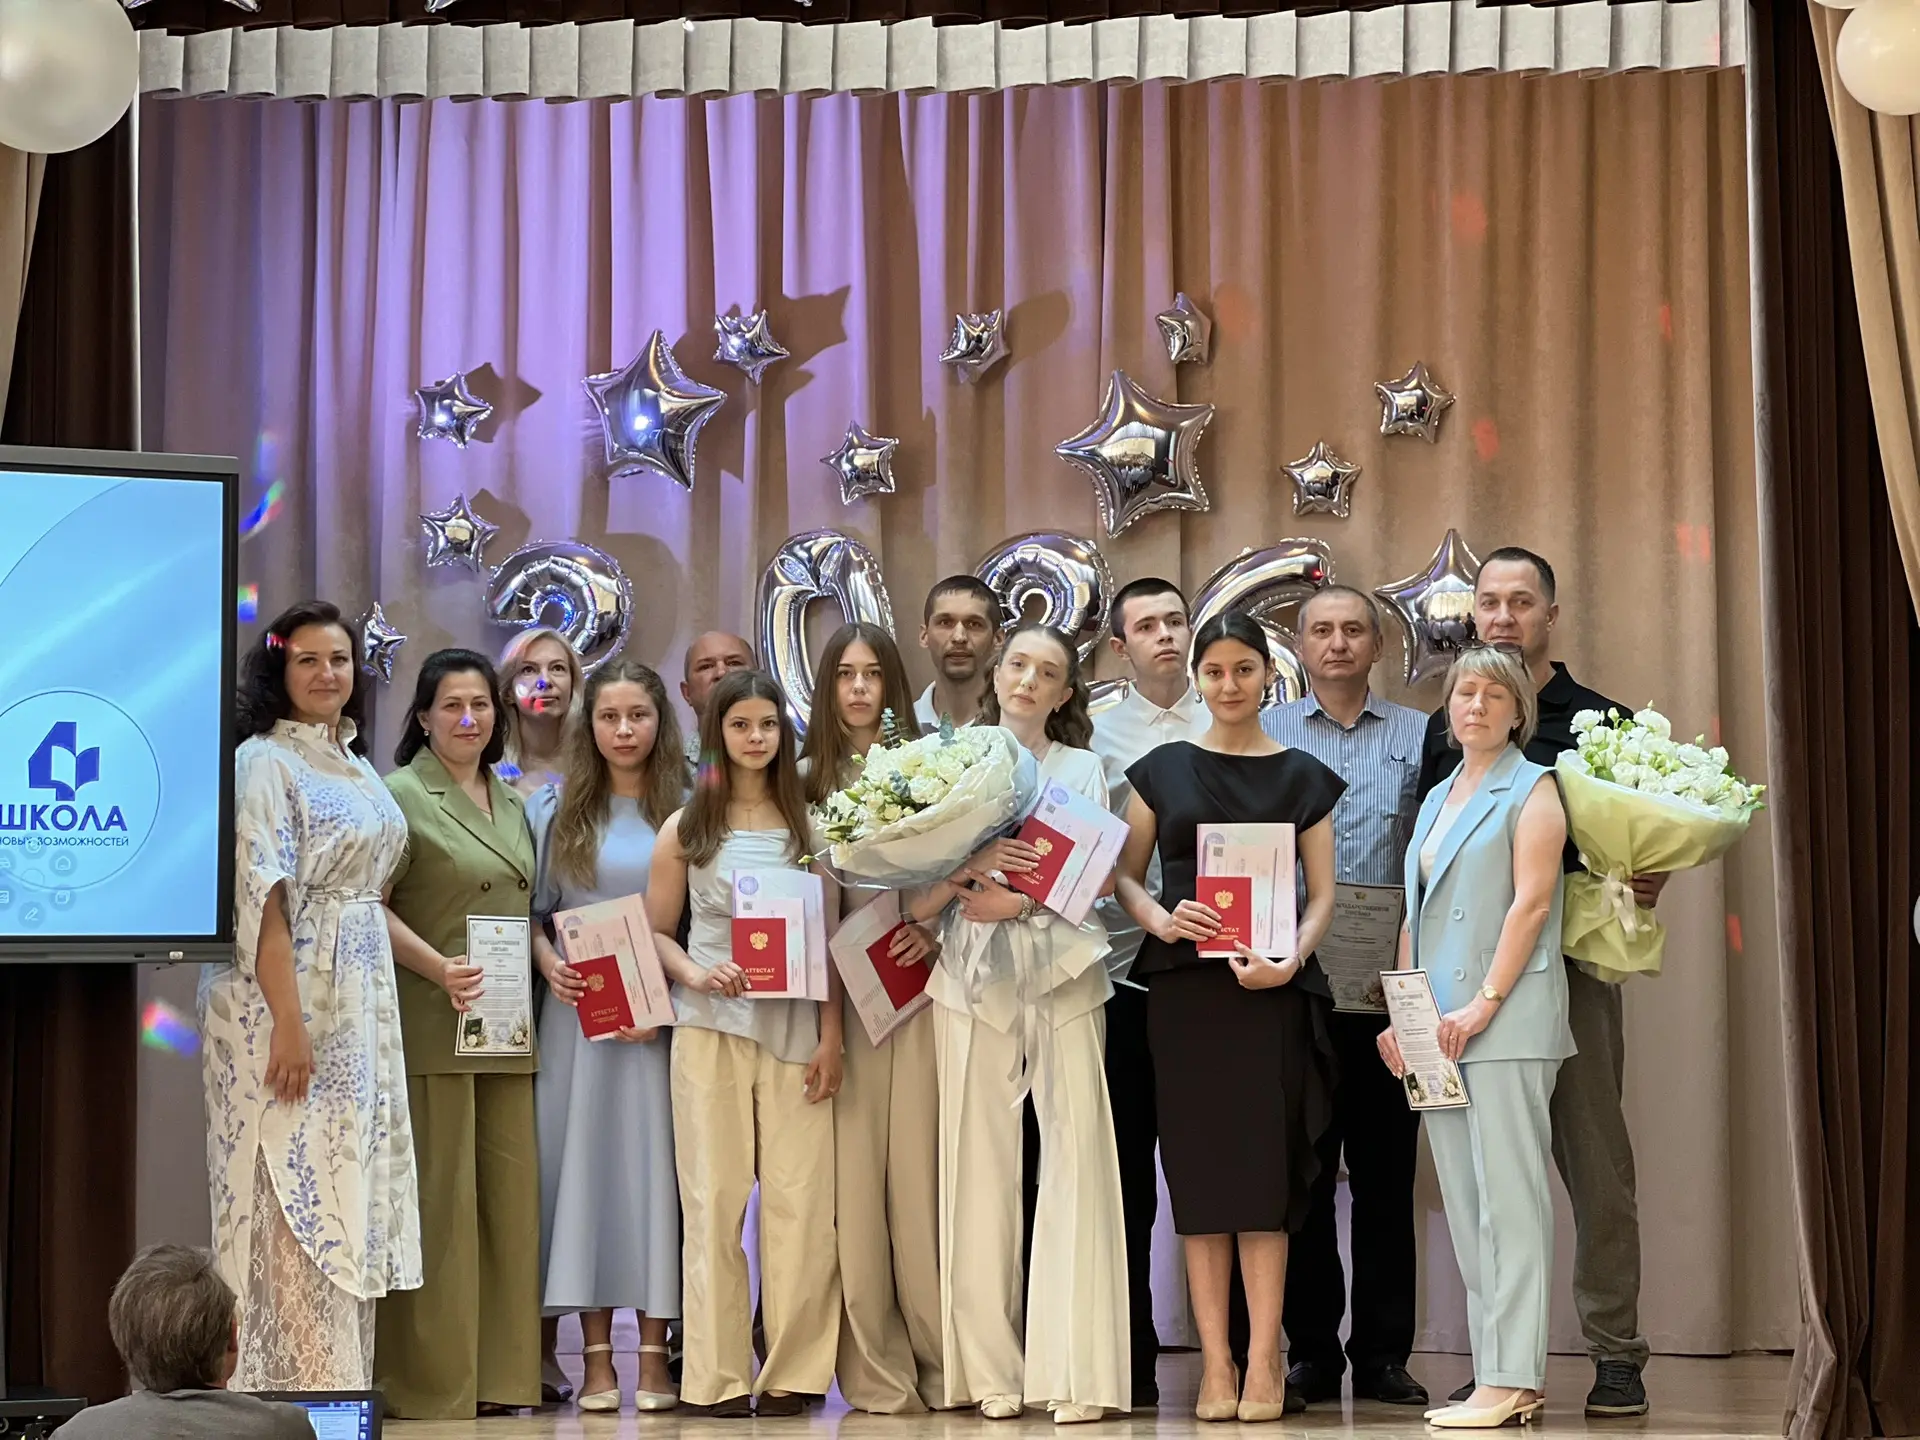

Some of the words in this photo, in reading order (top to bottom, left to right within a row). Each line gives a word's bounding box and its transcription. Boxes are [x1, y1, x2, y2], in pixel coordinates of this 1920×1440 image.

[0, 804, 128, 832] ШКОЛА
[37, 836, 129, 847] ВОЗМОЖНОСТЕЙ
[590, 1006, 619, 1018] АТТЕСТАТ
